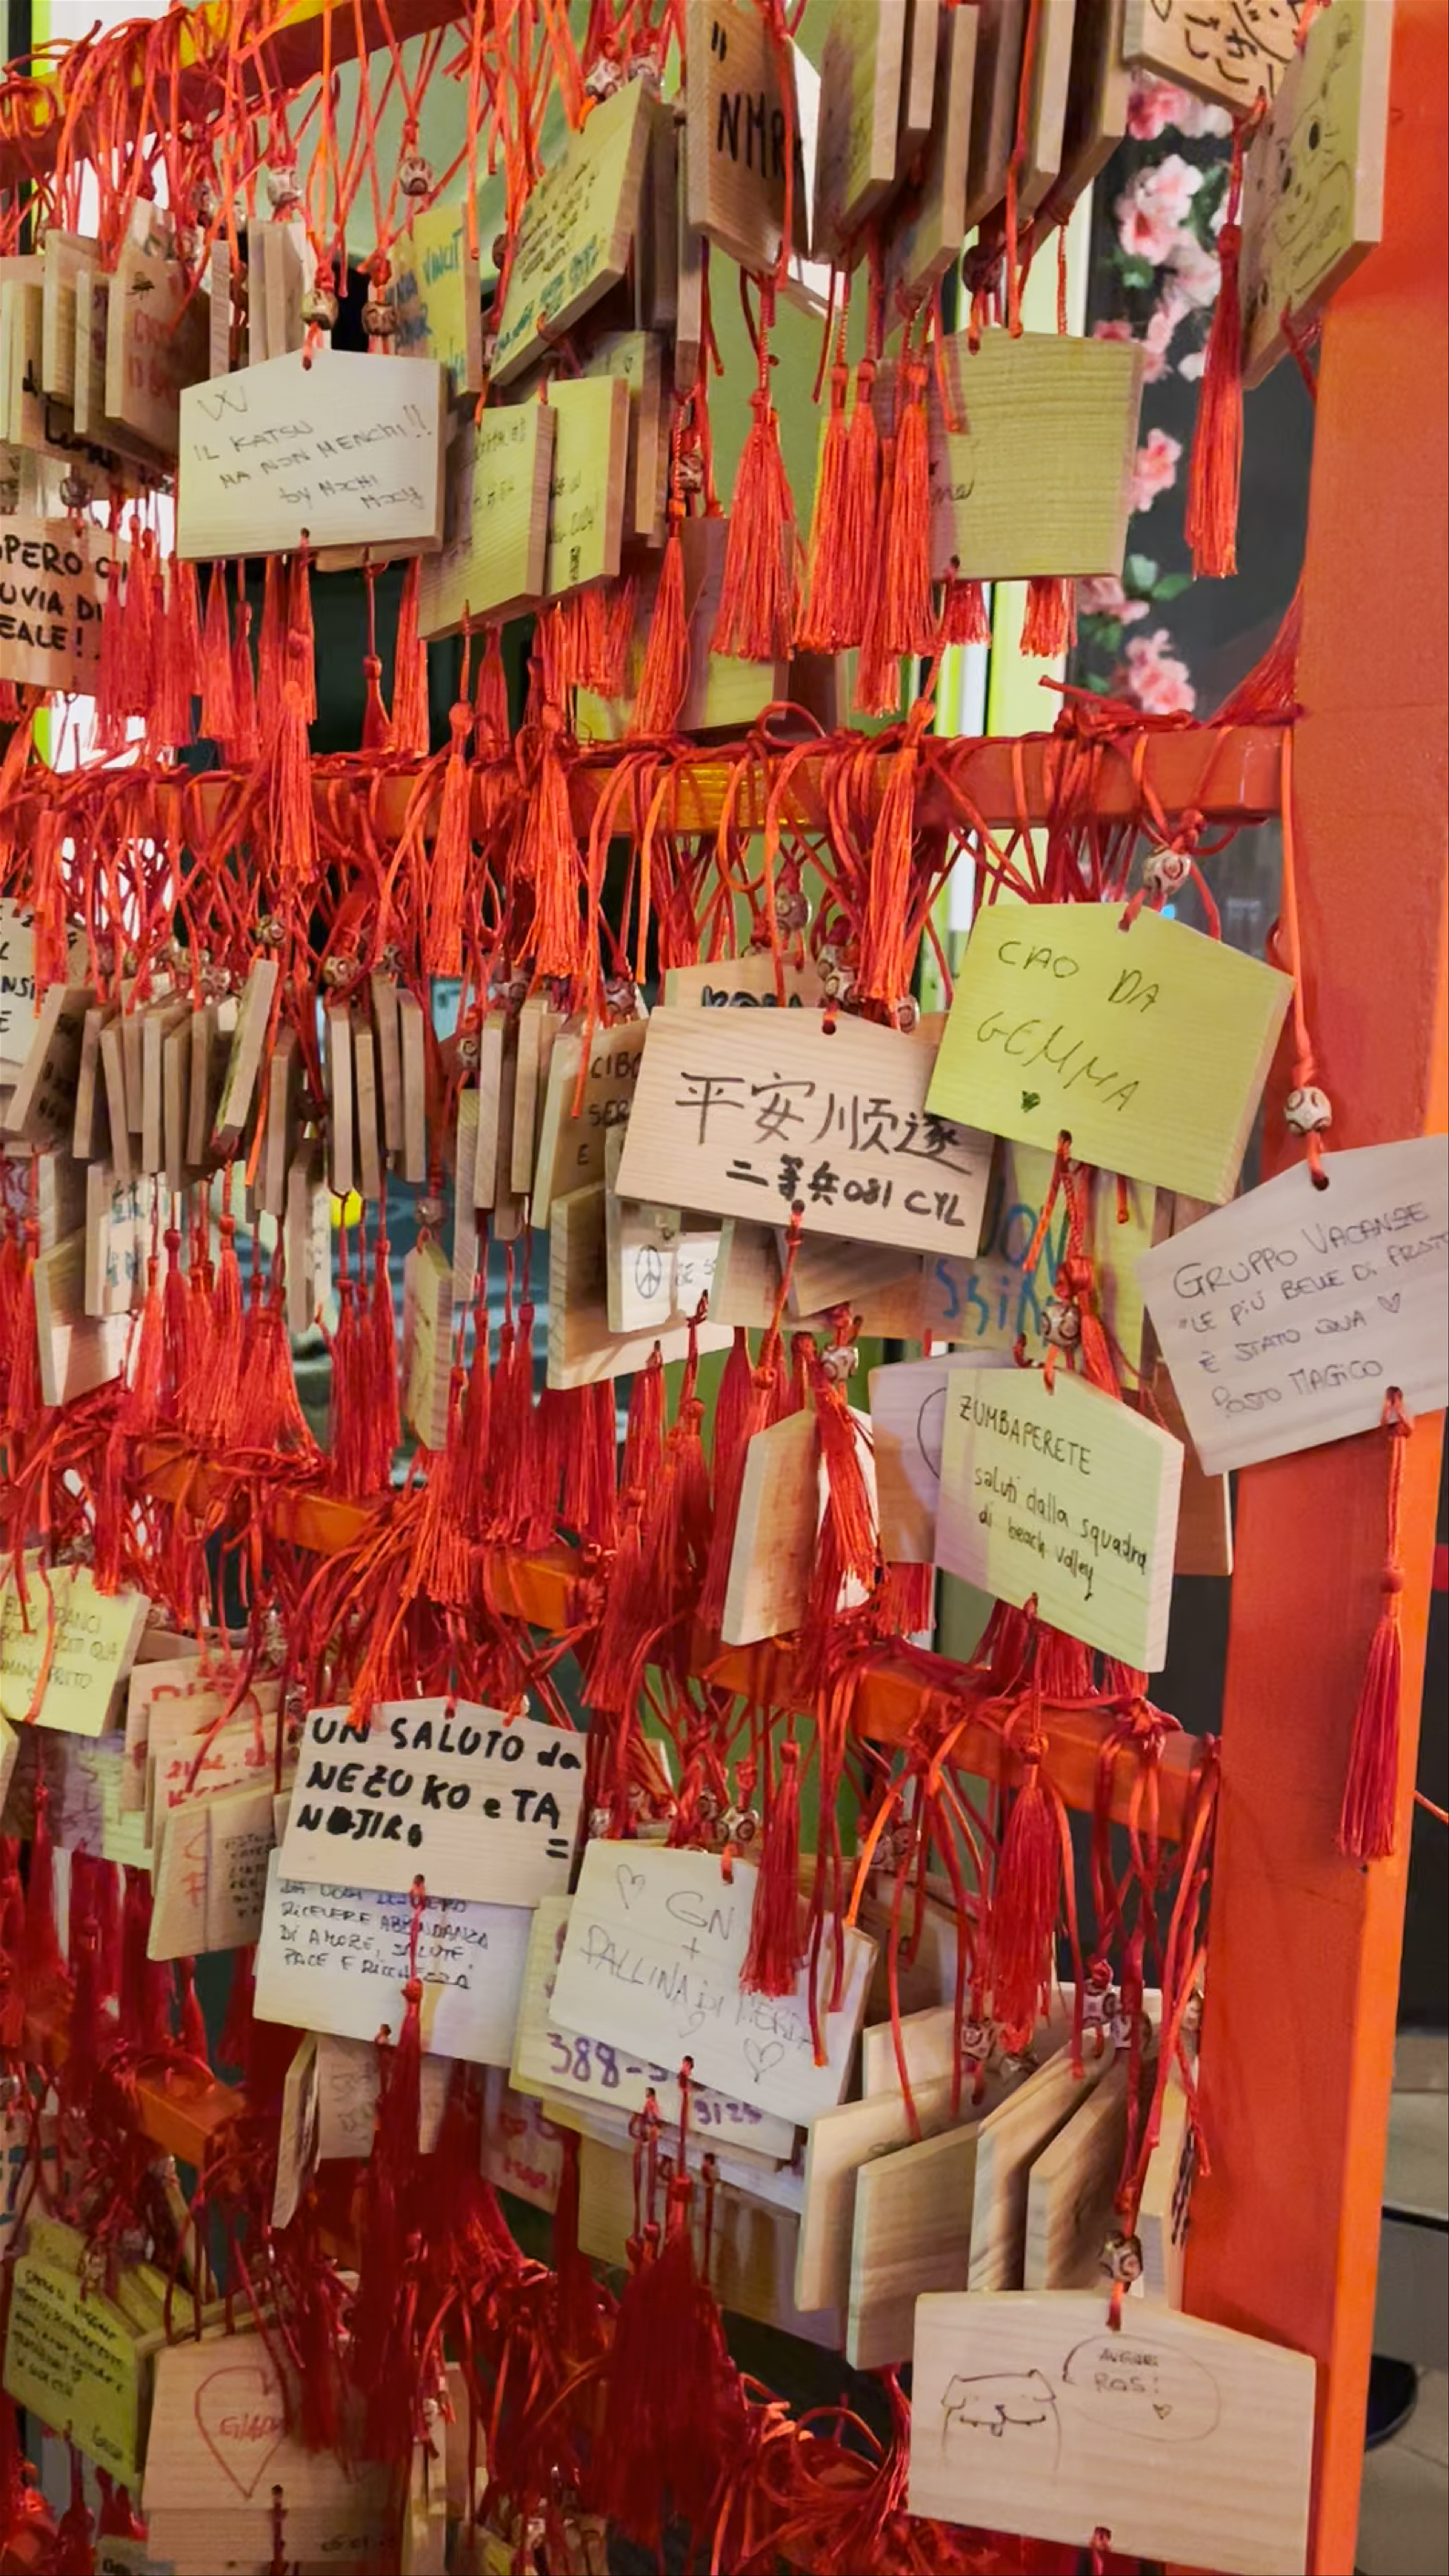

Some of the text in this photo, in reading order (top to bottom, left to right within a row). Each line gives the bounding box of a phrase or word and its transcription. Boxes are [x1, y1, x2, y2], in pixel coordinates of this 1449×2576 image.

[194, 420, 314, 462] IL KATSU
[278, 486, 314, 509] by
[0, 534, 83, 576] PERO
[1108, 969, 1160, 1013] DA
[977, 1011, 1140, 1112] GEMMA
[576, 1144, 589, 1166] E
[904, 1190, 966, 1227] CYL
[1173, 1201, 1430, 1298] GRUPPO VACANZE
[1234, 1329, 1301, 1362] STATO
[1314, 1309, 1367, 1335] QUA
[1212, 1385, 1283, 1418] POSTO
[959, 1395, 1092, 1475] ZUMBAPERETE
[974, 1466, 1148, 1576] saluti dalla squadra
[978, 1501, 995, 1528] di
[1008, 1516, 1046, 1559] beach
[312, 1717, 581, 1770] UN SALUTO da
[665, 1890, 735, 1940] GN
[580, 1924, 688, 2007] PALLINA
